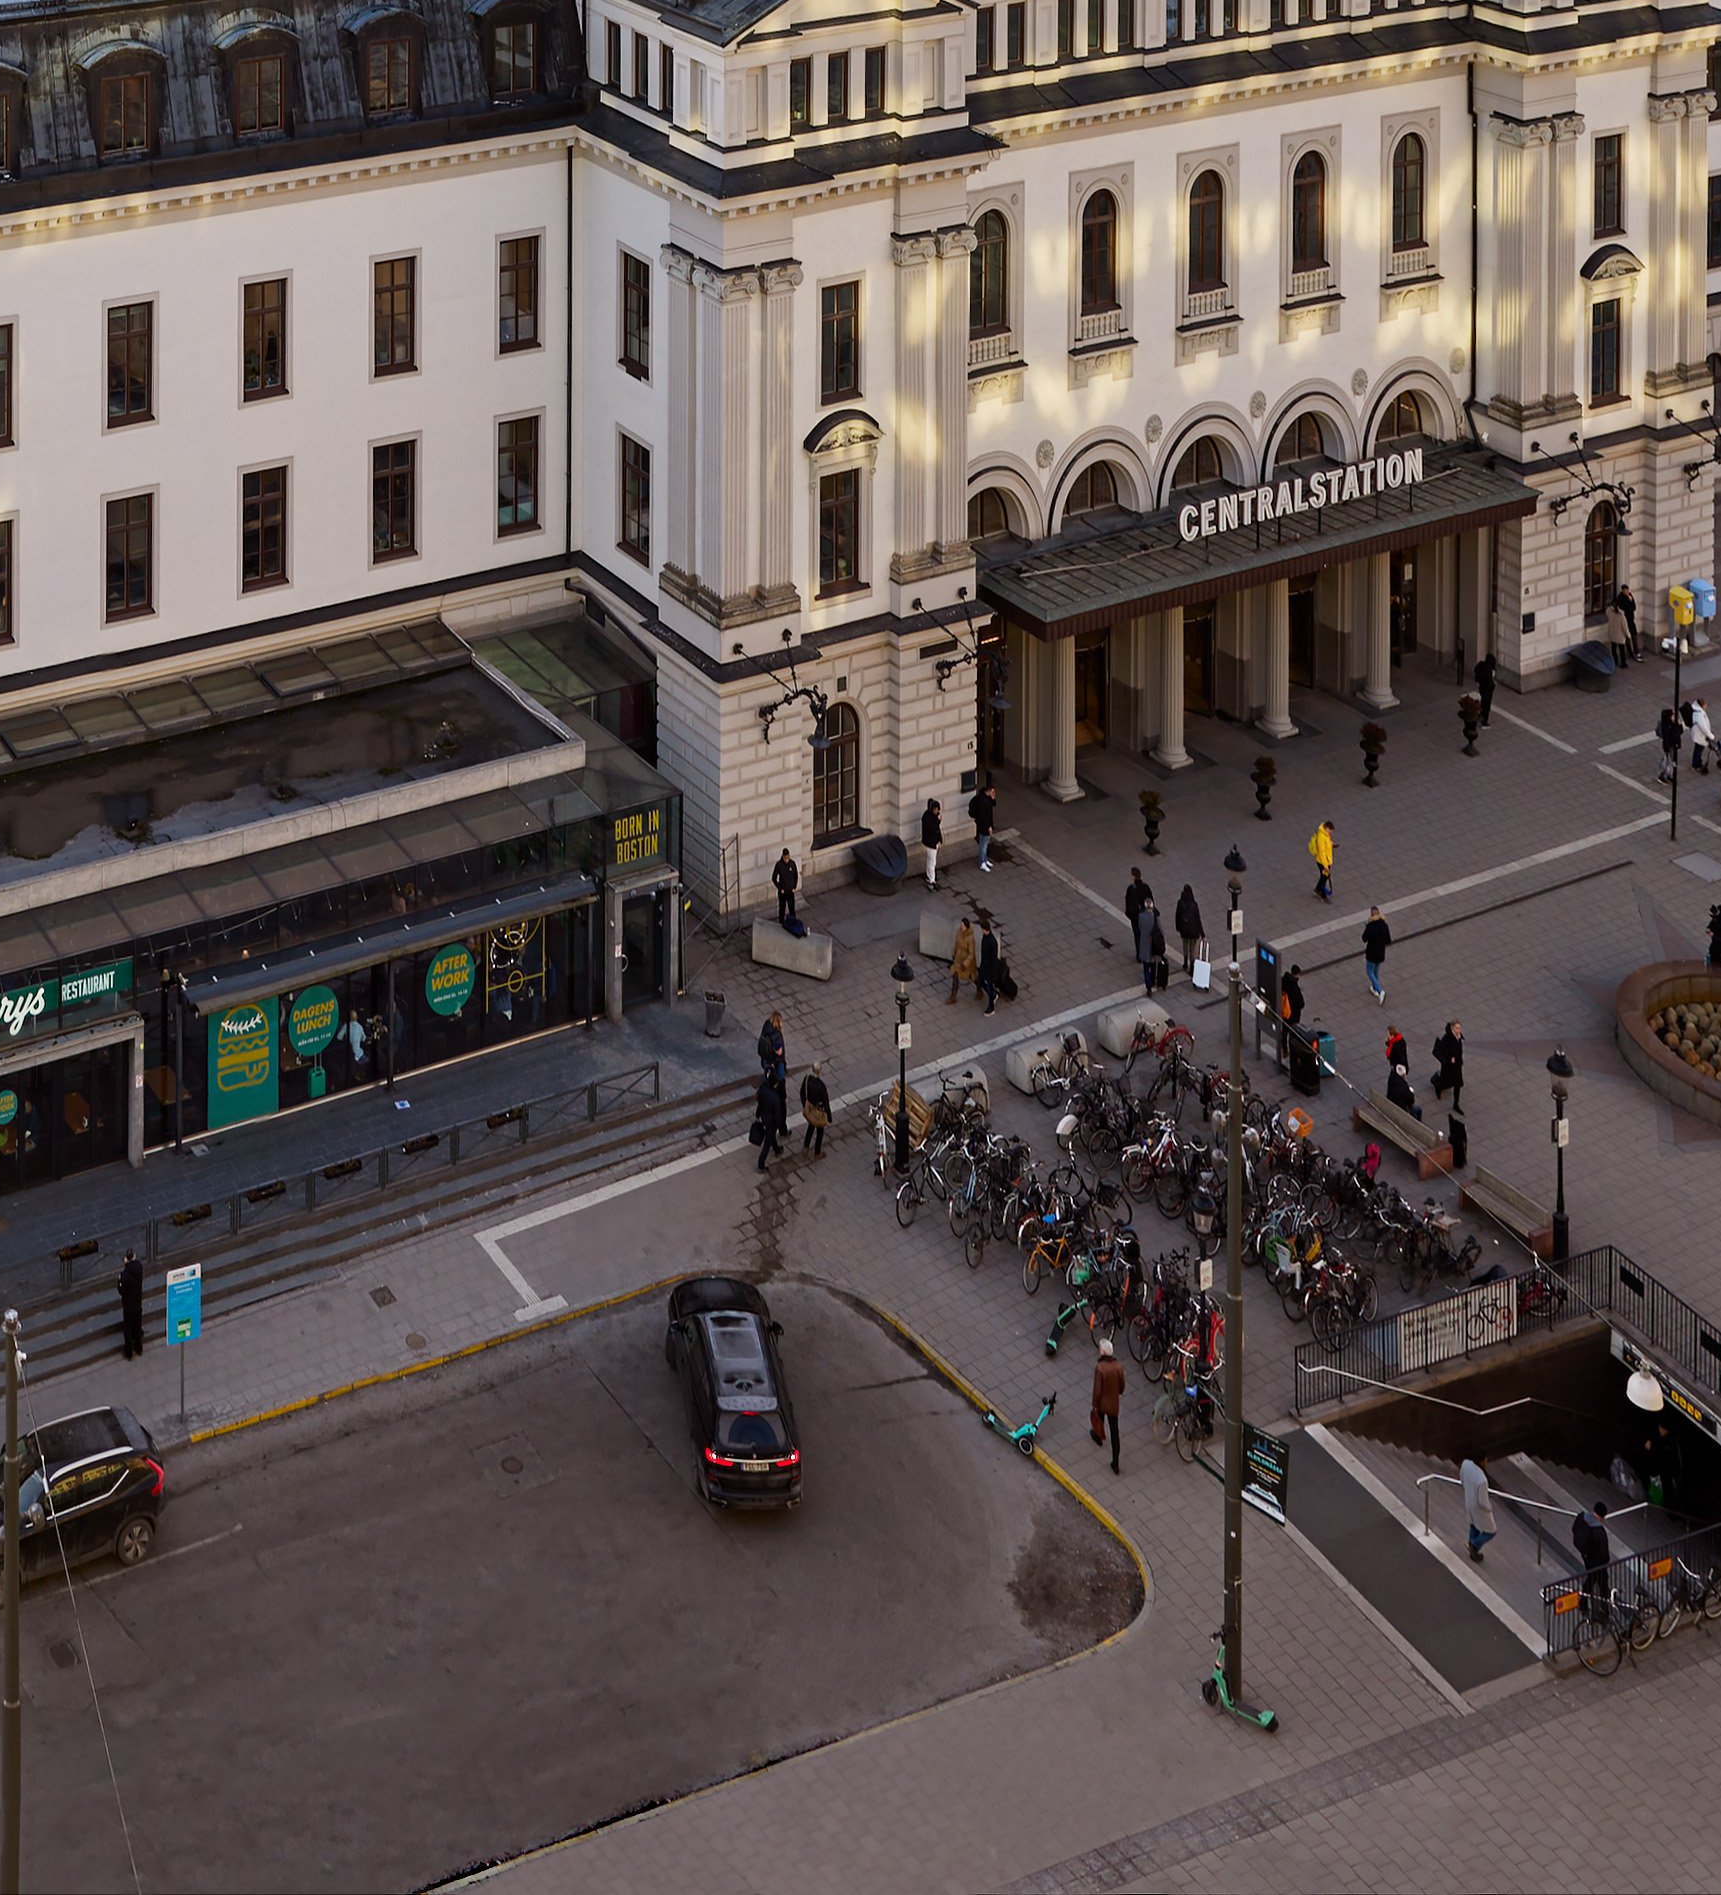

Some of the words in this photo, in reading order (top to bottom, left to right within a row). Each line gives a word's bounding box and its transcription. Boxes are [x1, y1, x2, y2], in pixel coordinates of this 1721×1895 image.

[1178, 447, 1424, 543] CENTRALSTATION
[615, 813, 642, 841] BORN
[648, 808, 659, 832] IN
[616, 833, 658, 865] BOSTON
[432, 953, 468, 976] AFTER
[61, 971, 116, 1002] RESTAURANT
[431, 969, 469, 992] WORK
[293, 999, 335, 1022] DAGENS
[296, 1014, 331, 1035] LUNCH
